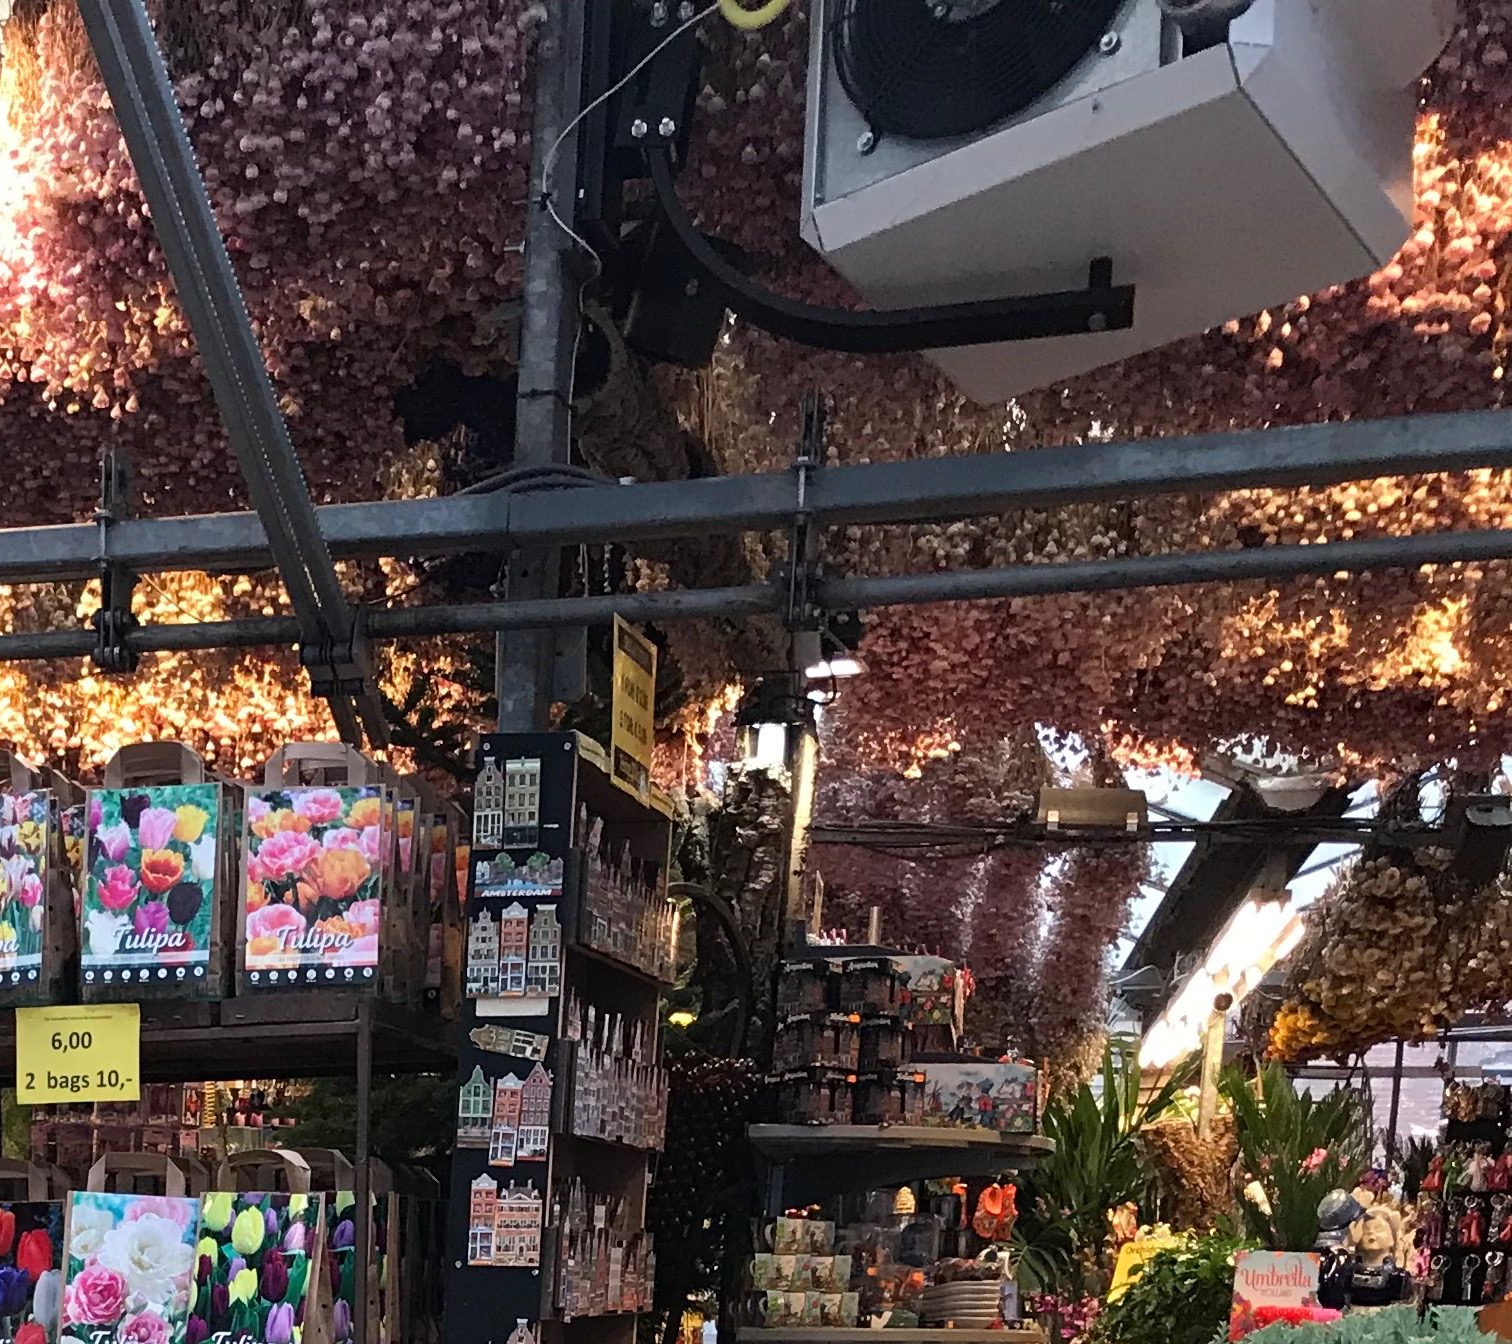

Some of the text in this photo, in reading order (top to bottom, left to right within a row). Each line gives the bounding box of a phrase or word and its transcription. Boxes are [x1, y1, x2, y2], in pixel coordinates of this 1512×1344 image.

[481, 889, 552, 897] AMSTERDAM
[114, 926, 186, 954] Tulipa
[277, 925, 353, 955] Tulipa
[51, 1031, 93, 1053] 6,00
[25, 1069, 133, 1092] 2 bags 10,-
[1240, 1256, 1313, 1291] Umbrella
